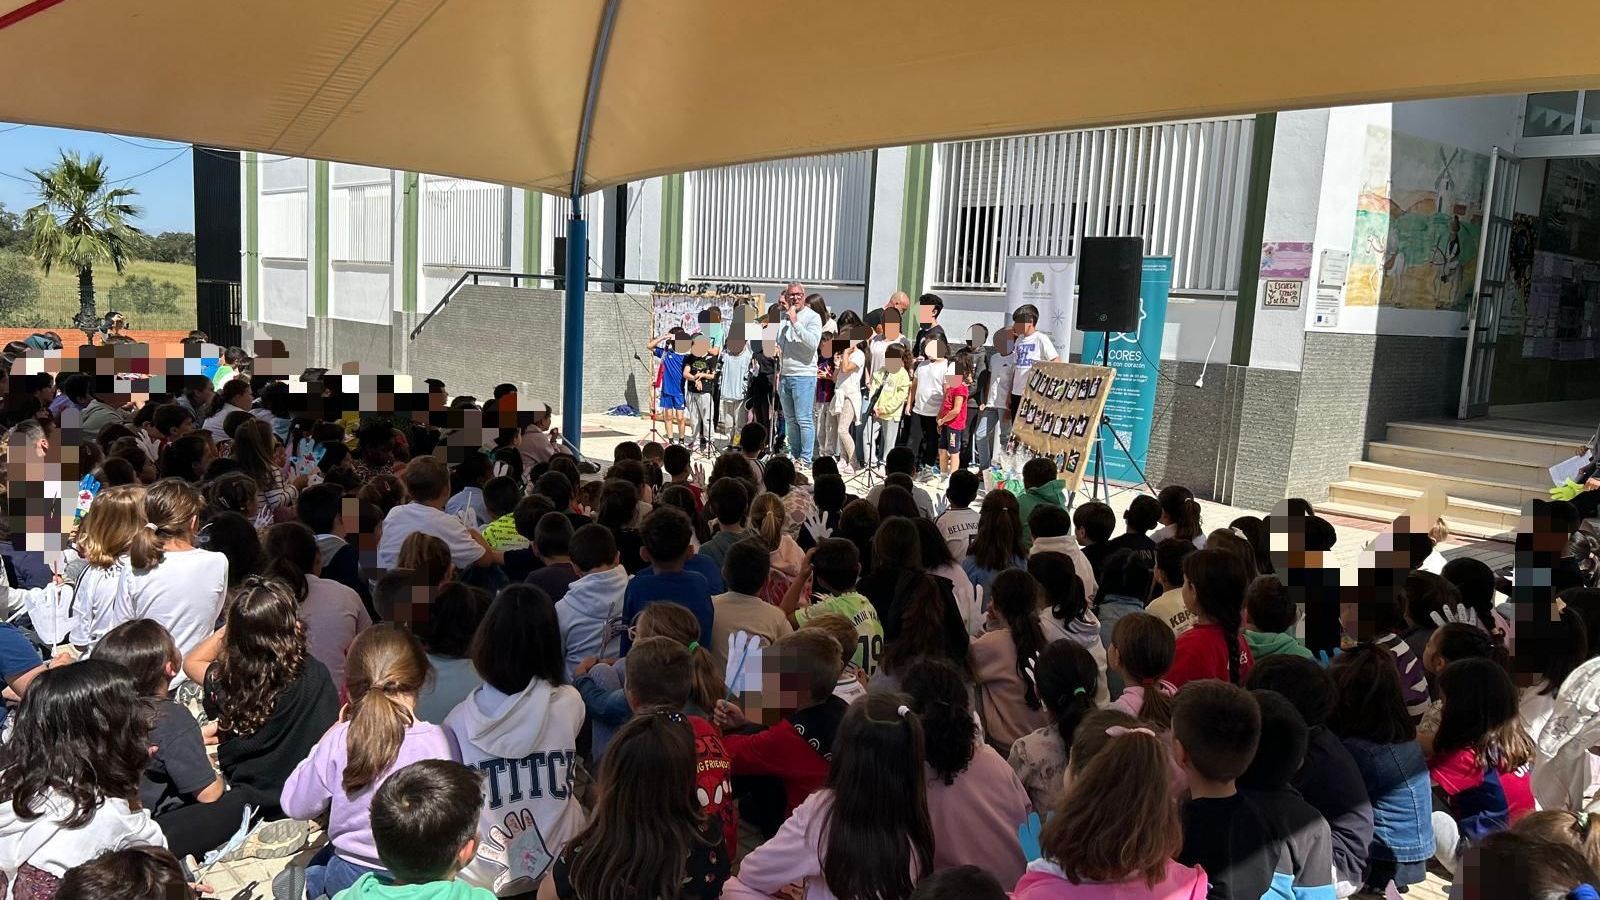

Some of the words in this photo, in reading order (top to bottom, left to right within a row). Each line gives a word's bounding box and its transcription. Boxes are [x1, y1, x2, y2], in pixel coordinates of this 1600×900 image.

[1274, 282, 1296, 290] ESCUELA
[1096, 349, 1142, 361] ACORES
[947, 522, 979, 535] BELLING
